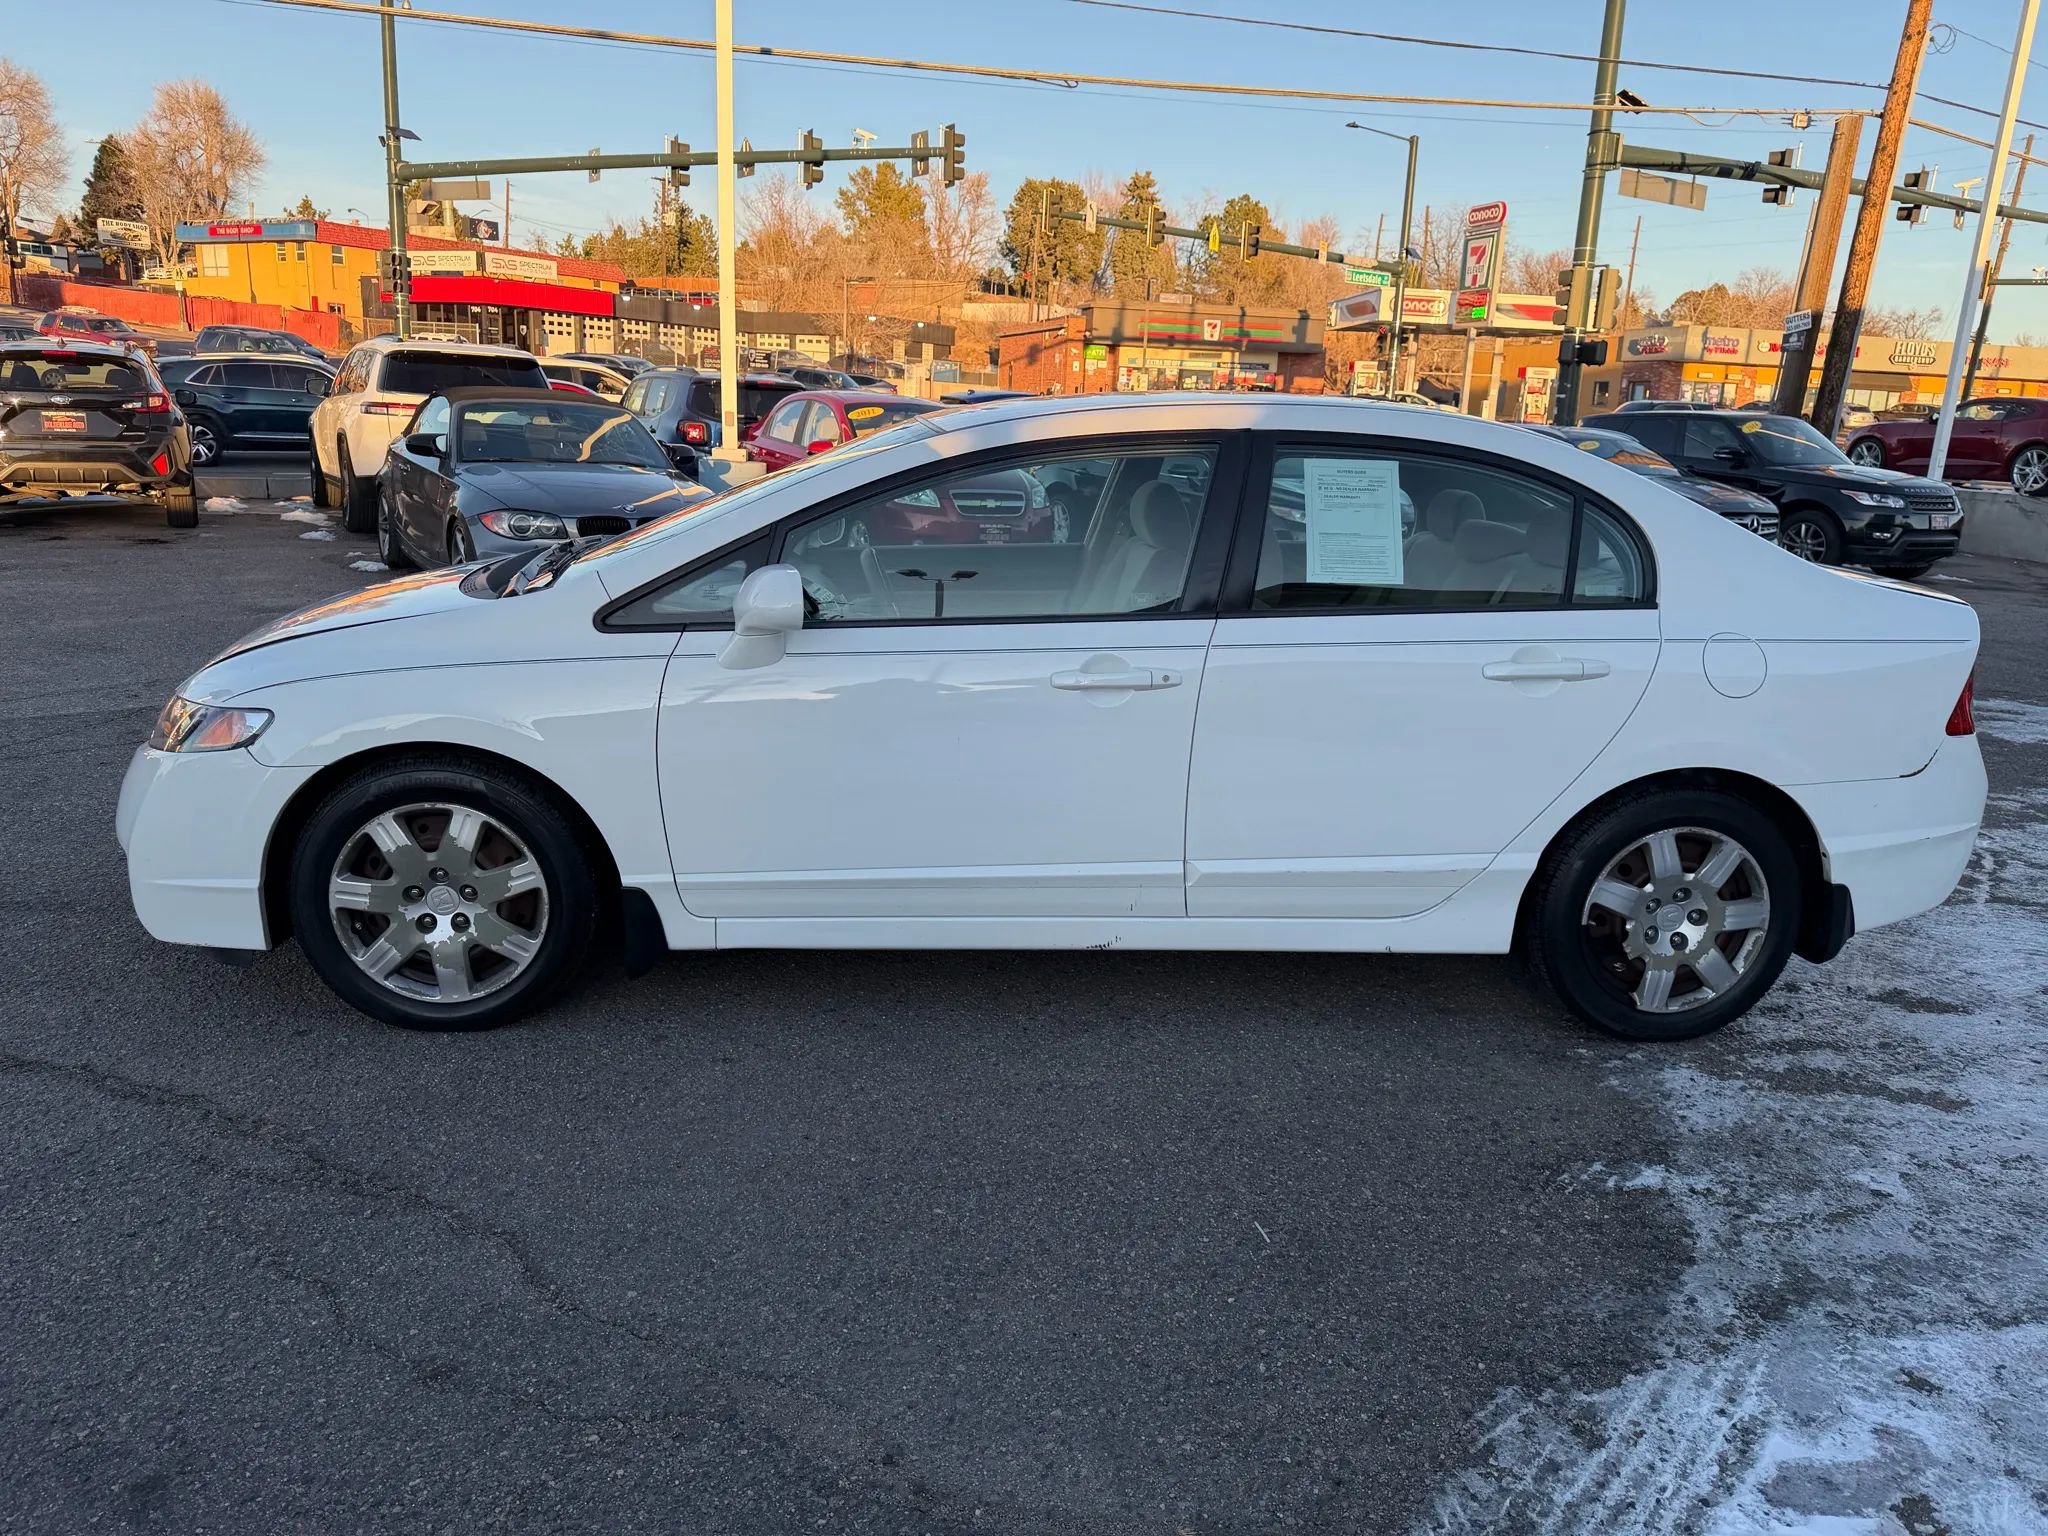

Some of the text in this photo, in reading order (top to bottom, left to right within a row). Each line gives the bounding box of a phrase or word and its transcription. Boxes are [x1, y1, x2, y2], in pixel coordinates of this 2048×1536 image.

[519, 260, 553, 271] SPECTRUM
[1785, 312, 1810, 325] GUTTERS
[1707, 335, 1739, 347] metro
[1894, 355, 1934, 364] BARBERSHOP
